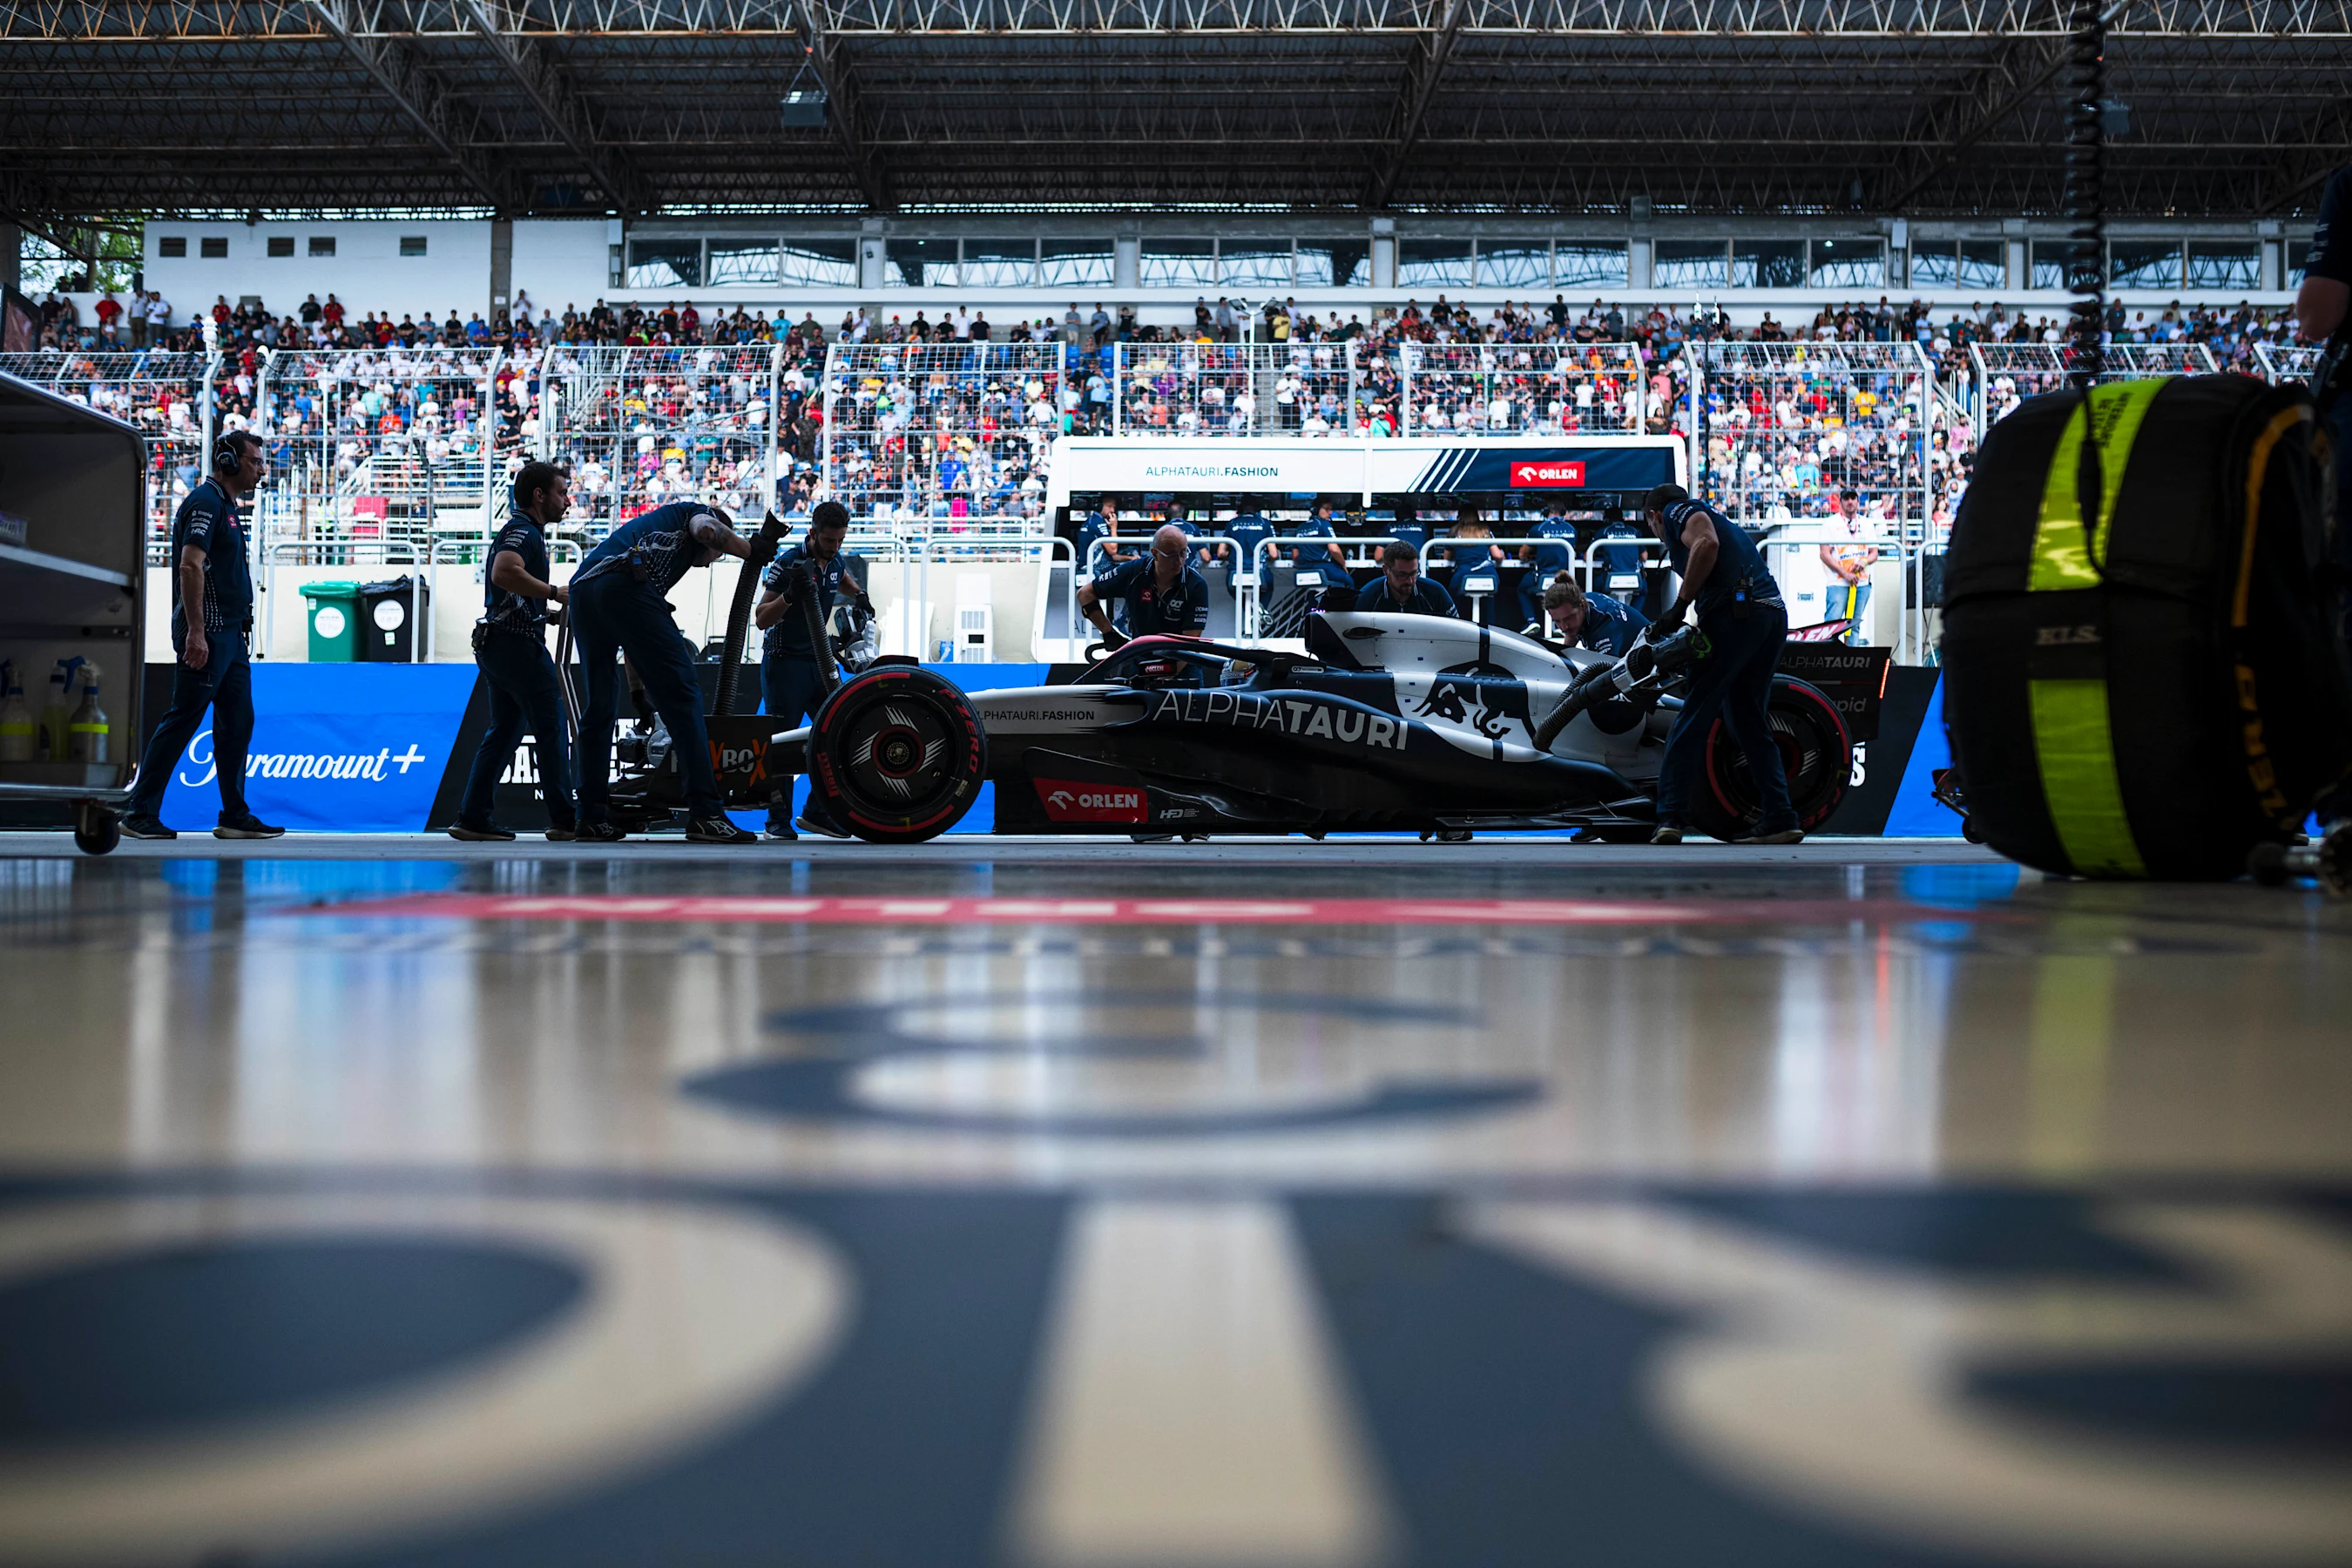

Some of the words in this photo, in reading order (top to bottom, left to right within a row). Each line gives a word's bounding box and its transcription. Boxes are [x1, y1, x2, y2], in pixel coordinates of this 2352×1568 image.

[1146, 466, 1278, 476] ALPHATAURI.FASHION
[1538, 469, 1578, 480] ORLEN
[978, 711, 1095, 720] PHATAURI.FASHION
[1152, 690, 1409, 750] ALPHATAURI
[956, 704, 979, 774] ZERO
[1078, 794, 1139, 808] ORLEN
